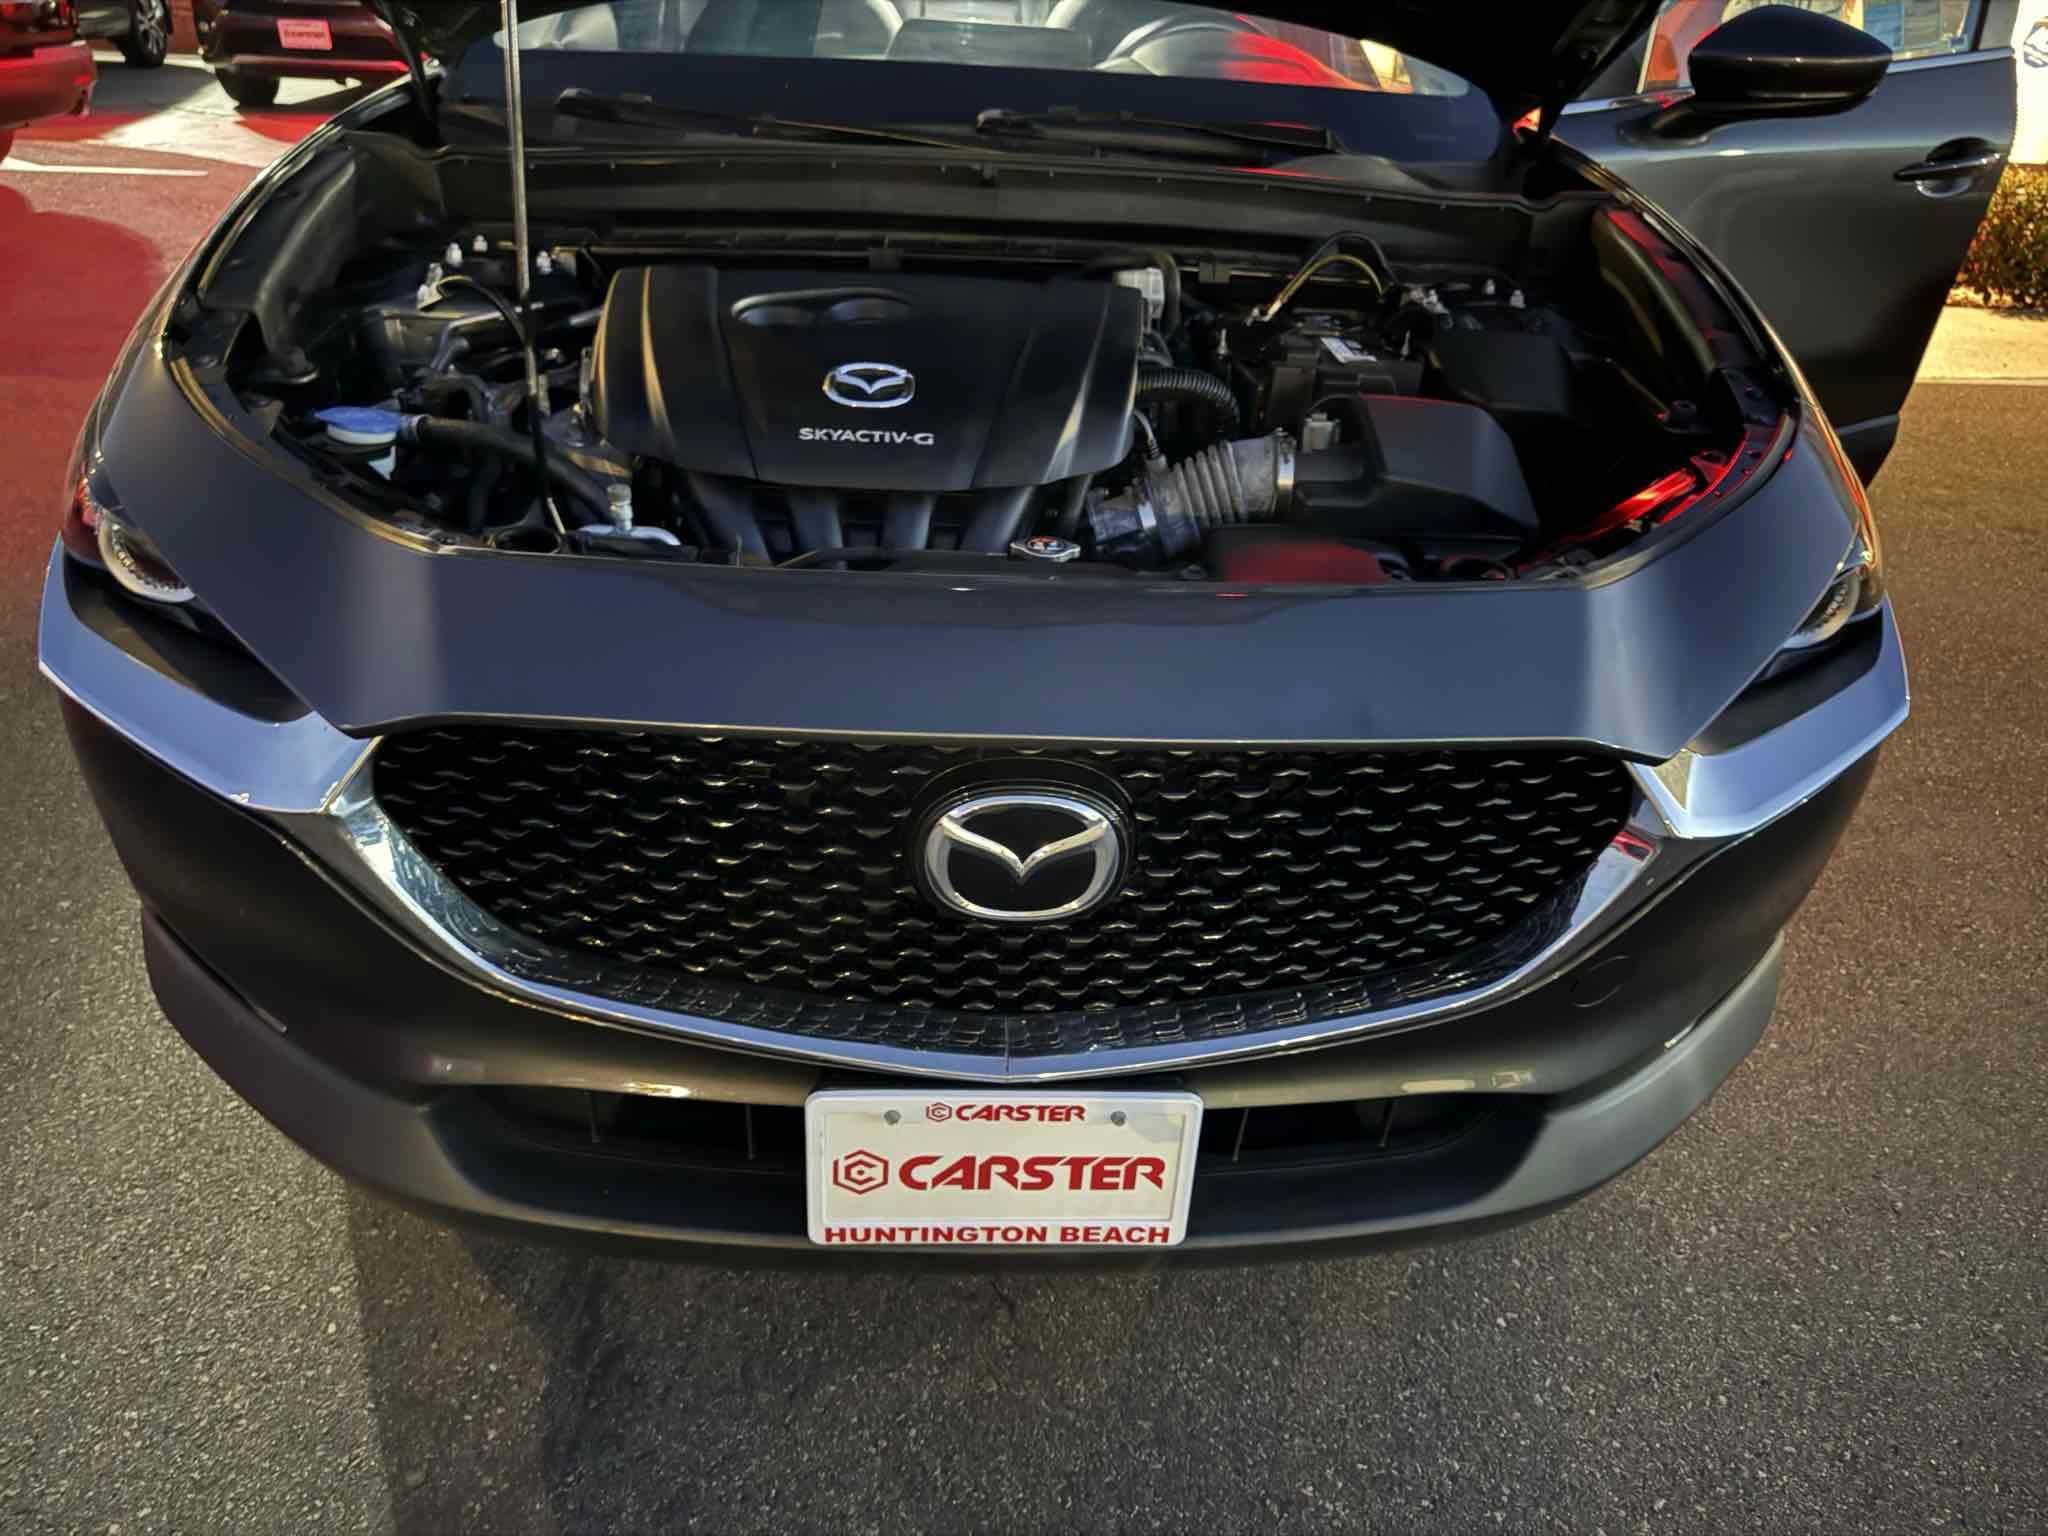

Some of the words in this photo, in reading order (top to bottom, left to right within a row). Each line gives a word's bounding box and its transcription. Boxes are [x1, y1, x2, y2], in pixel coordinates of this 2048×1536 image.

[799, 427, 935, 445] SKYACTIV-G
[955, 1103, 1085, 1122] CARSTER
[898, 1155, 1167, 1191] CARSTER
[825, 1226, 1048, 1243] HUNTINGTON
[1060, 1226, 1170, 1244] BEACH
